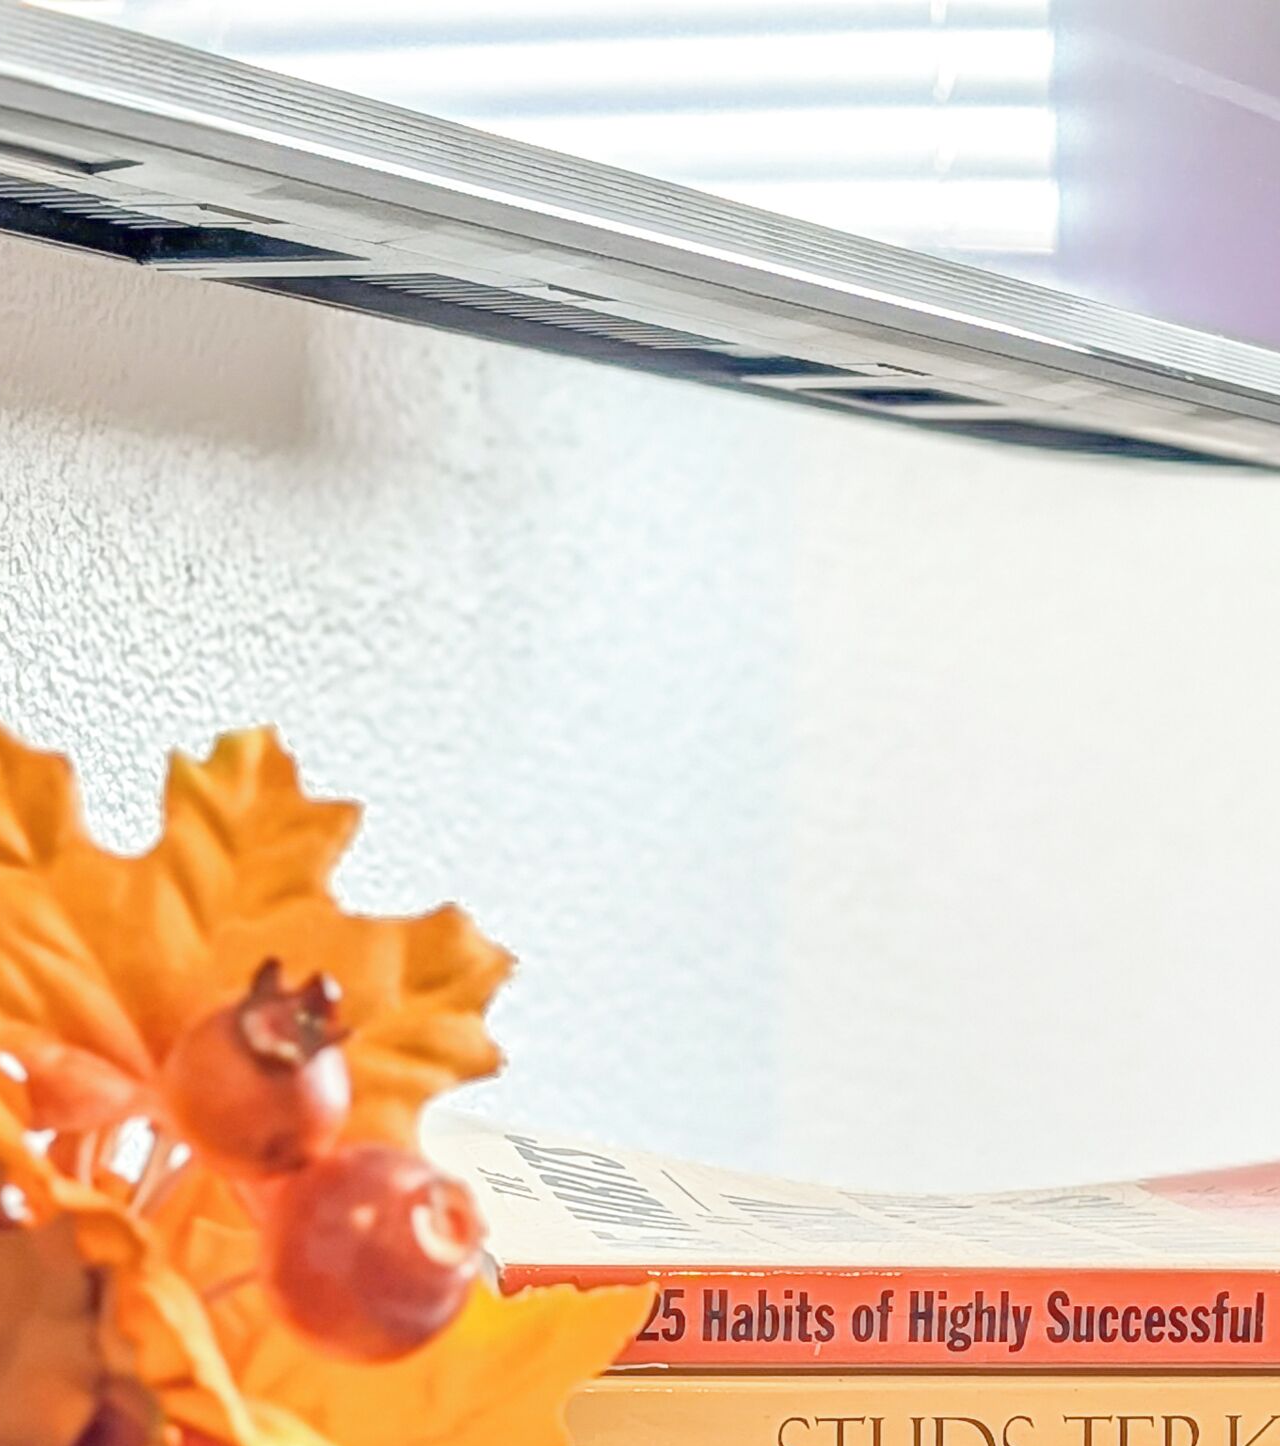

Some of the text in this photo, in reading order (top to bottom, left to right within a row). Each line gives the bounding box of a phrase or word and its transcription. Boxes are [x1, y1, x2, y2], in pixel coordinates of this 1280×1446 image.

[635, 1289, 685, 1342] 25
[702, 1289, 835, 1343] Habits
[852, 1290, 894, 1342] of
[908, 1290, 1033, 1352] Highly
[1046, 1290, 1265, 1343] Successful
